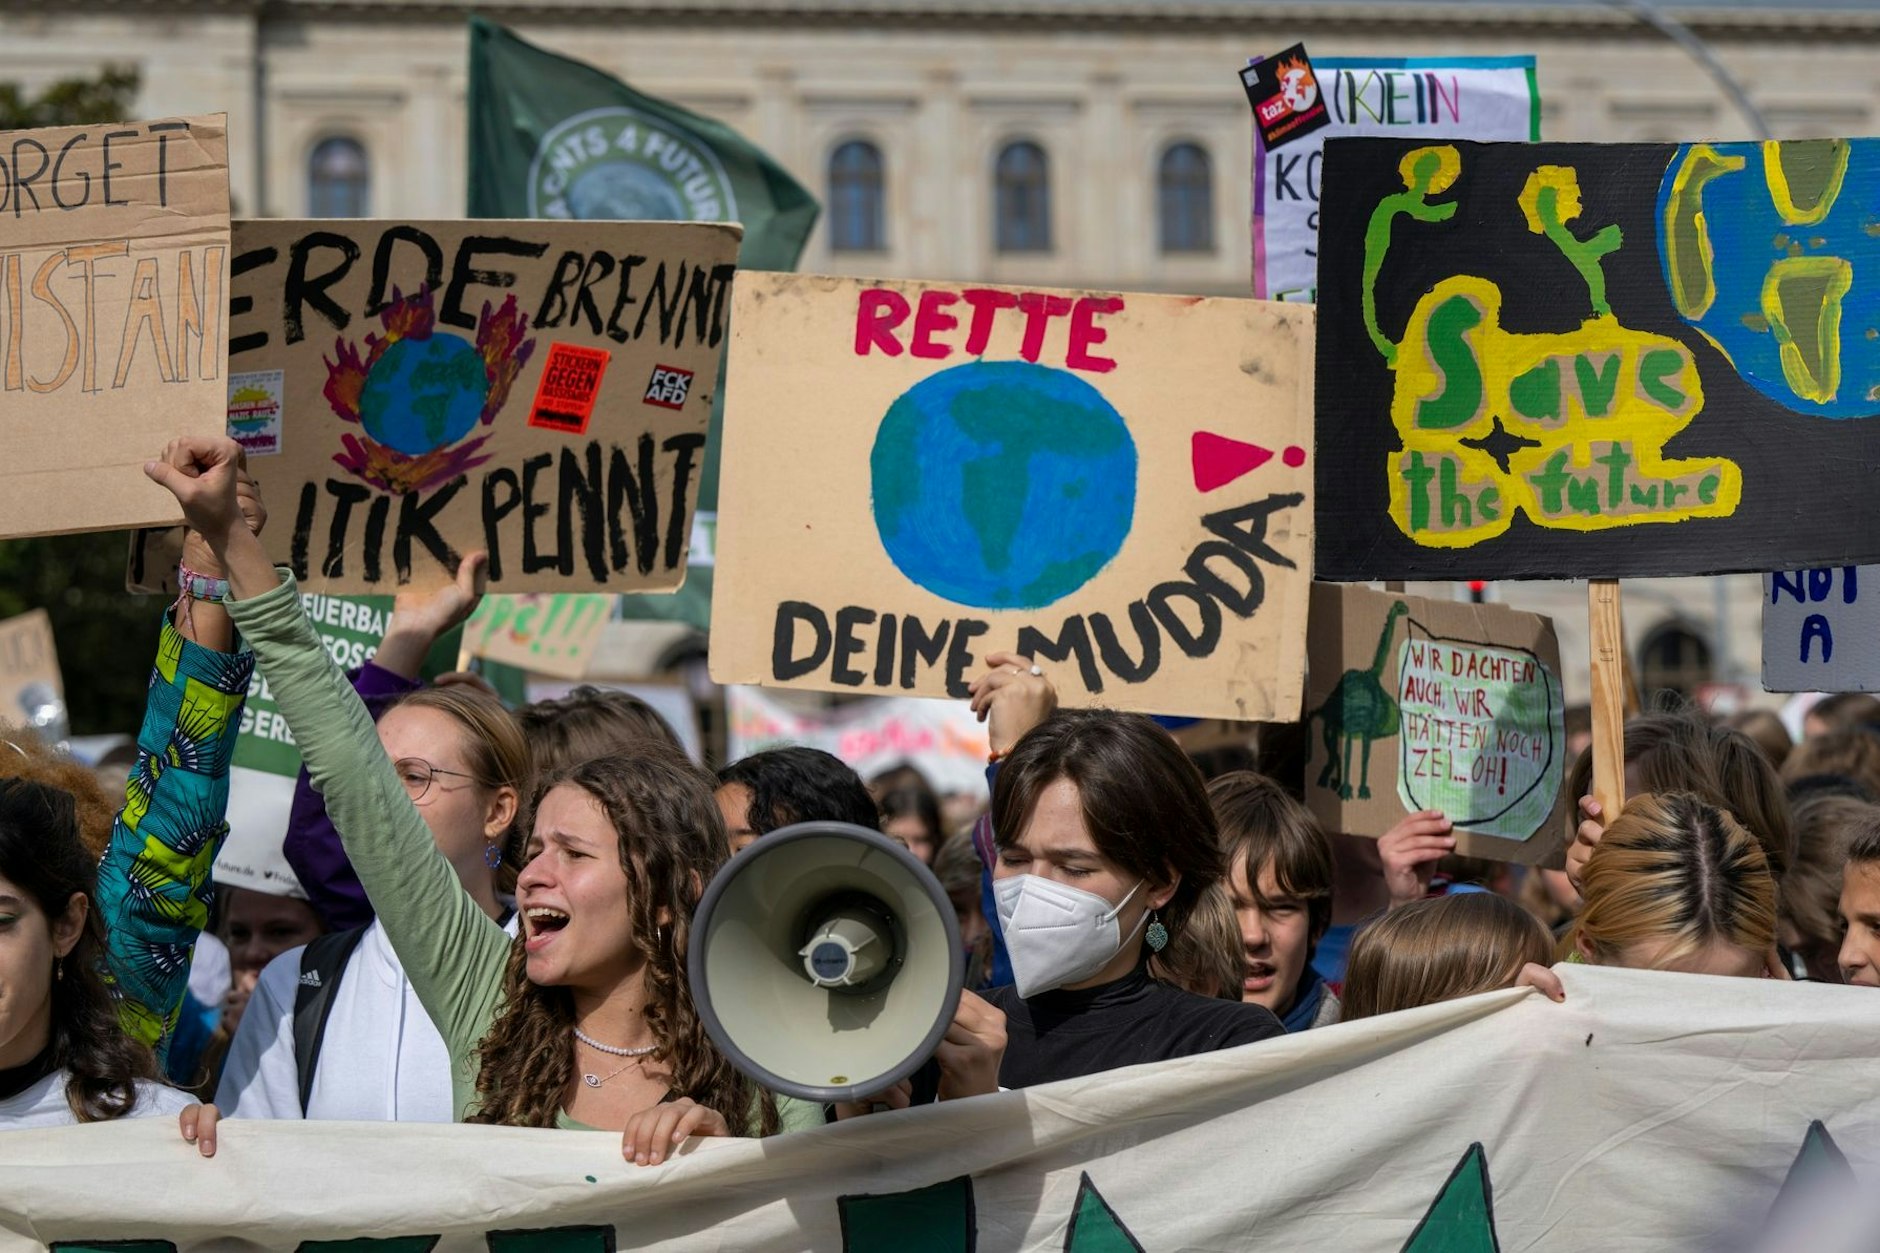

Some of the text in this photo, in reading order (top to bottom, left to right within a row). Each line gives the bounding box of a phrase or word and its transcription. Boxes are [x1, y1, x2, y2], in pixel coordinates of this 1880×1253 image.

[1262, 101, 1285, 120] taz
[615, 124, 639, 154] 4
[0, 123, 189, 218] RGET
[0, 240, 225, 394] ISTAN
[532, 250, 736, 349] BRENNT
[855, 288, 1124, 372] RETTE
[545, 366, 599, 392] GEGEN
[551, 351, 601, 372] STICKERN
[652, 369, 691, 390] FCK
[1416, 294, 1687, 429] Save
[646, 386, 686, 406] AFD
[274, 474, 467, 585] ITIK
[482, 432, 705, 583] PENNT
[1401, 440, 1719, 534] the future
[772, 600, 989, 697] DEINE
[1800, 613, 1833, 663] A
[1411, 644, 1535, 684] WIR DACHTEN
[1453, 688, 1494, 719] WIR
[1408, 712, 1542, 761] HÄTTEN NOCH
[1471, 753, 1508, 796] OH!
